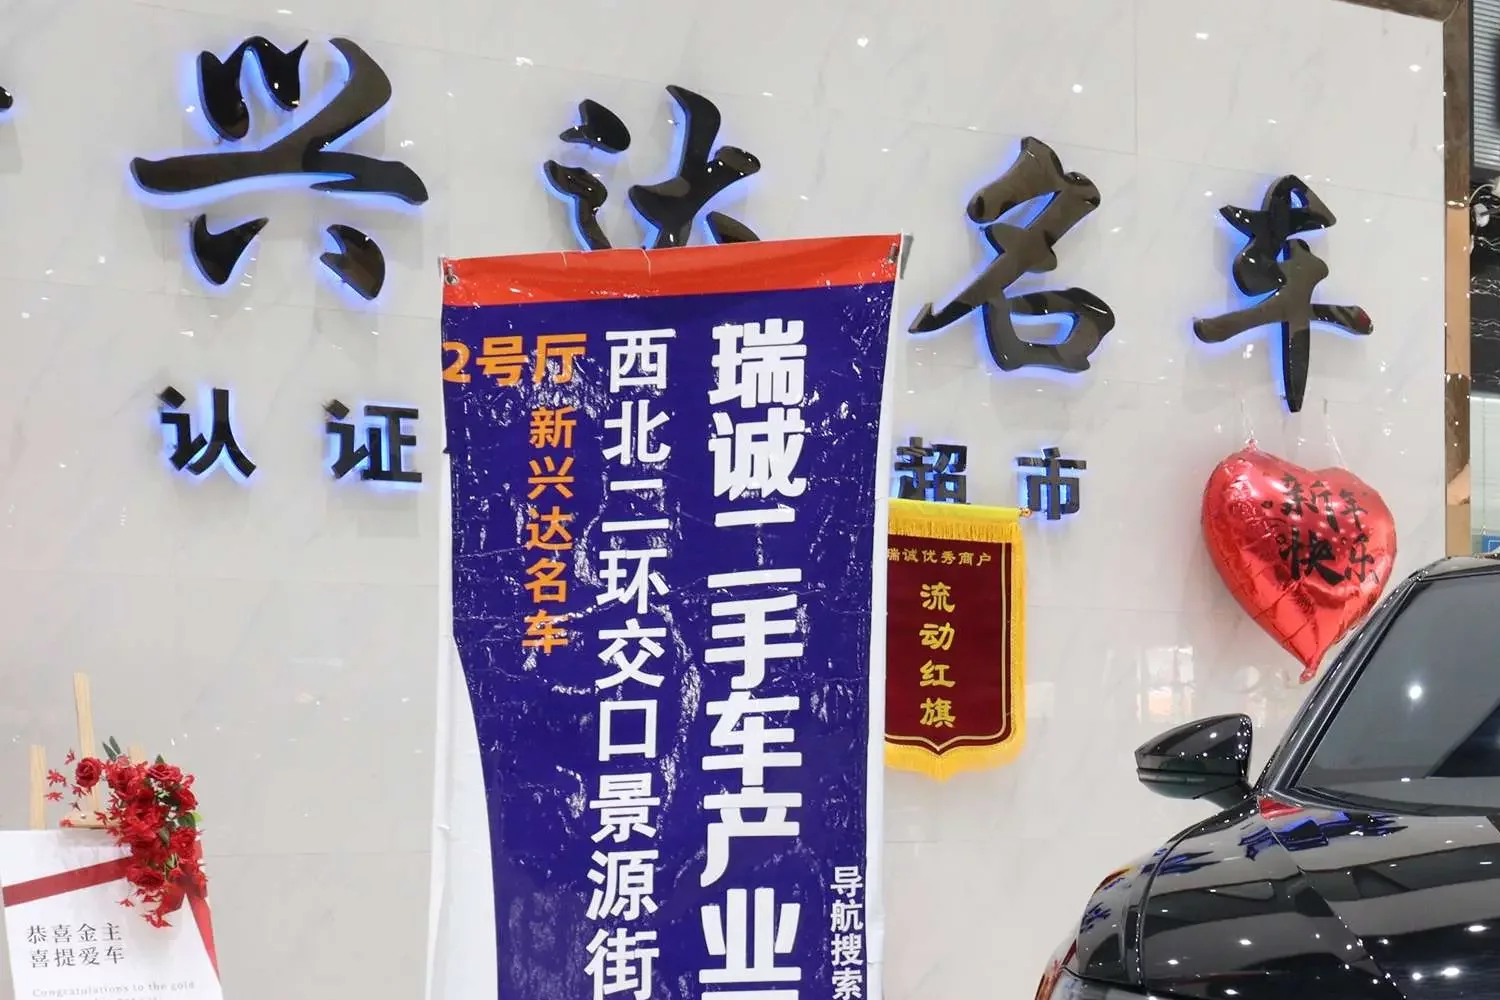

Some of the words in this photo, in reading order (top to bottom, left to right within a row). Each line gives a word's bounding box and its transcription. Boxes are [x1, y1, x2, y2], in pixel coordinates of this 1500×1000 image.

[0, 36, 1374, 413] 兴达名车
[442, 332, 587, 386] 2号厅
[521, 405, 577, 656] 新兴达名车
[887, 548, 992, 567] 瑞诚优秀商户
[919, 581, 956, 728] 流动红旗
[26, 922, 123, 944] 恭喜金主
[30, 946, 125, 968] 喜提爱车
[32, 985, 129, 998] Congratulations
[133, 983, 144, 992] to
[148, 981, 166, 991] the
[170, 980, 195, 992] gold
